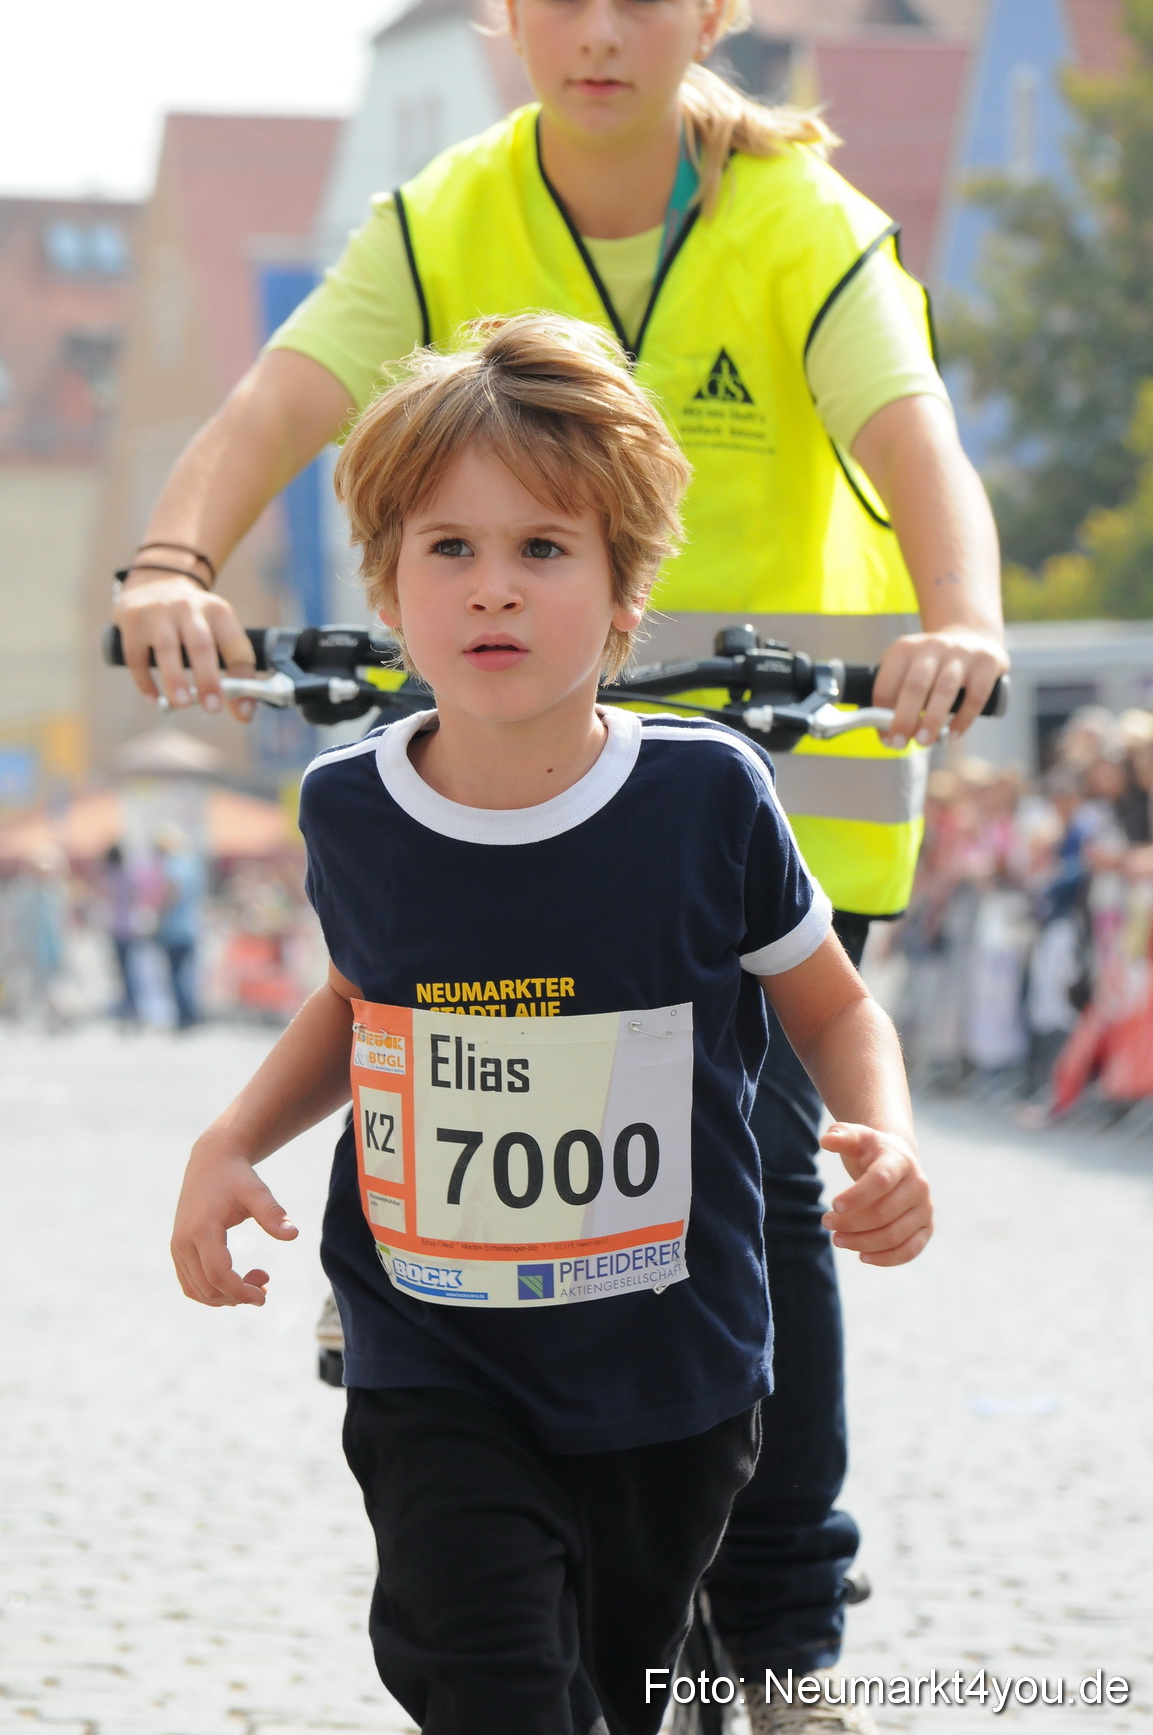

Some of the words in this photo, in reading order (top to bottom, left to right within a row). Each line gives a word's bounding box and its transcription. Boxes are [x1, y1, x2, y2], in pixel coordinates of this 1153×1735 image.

[416, 977, 575, 1003] NEUMARKTER
[429, 1001, 561, 1018] DTLAUF
[368, 1051, 405, 1068] BÖGL
[430, 1033, 530, 1093] Elias
[365, 1110, 396, 1155] K2
[436, 1122, 660, 1209] 7000
[393, 1258, 463, 1289] BOCK
[560, 1240, 681, 1283] PFLEIDERER
[560, 1263, 684, 1298] AKTIENGESELLSCHAFT
